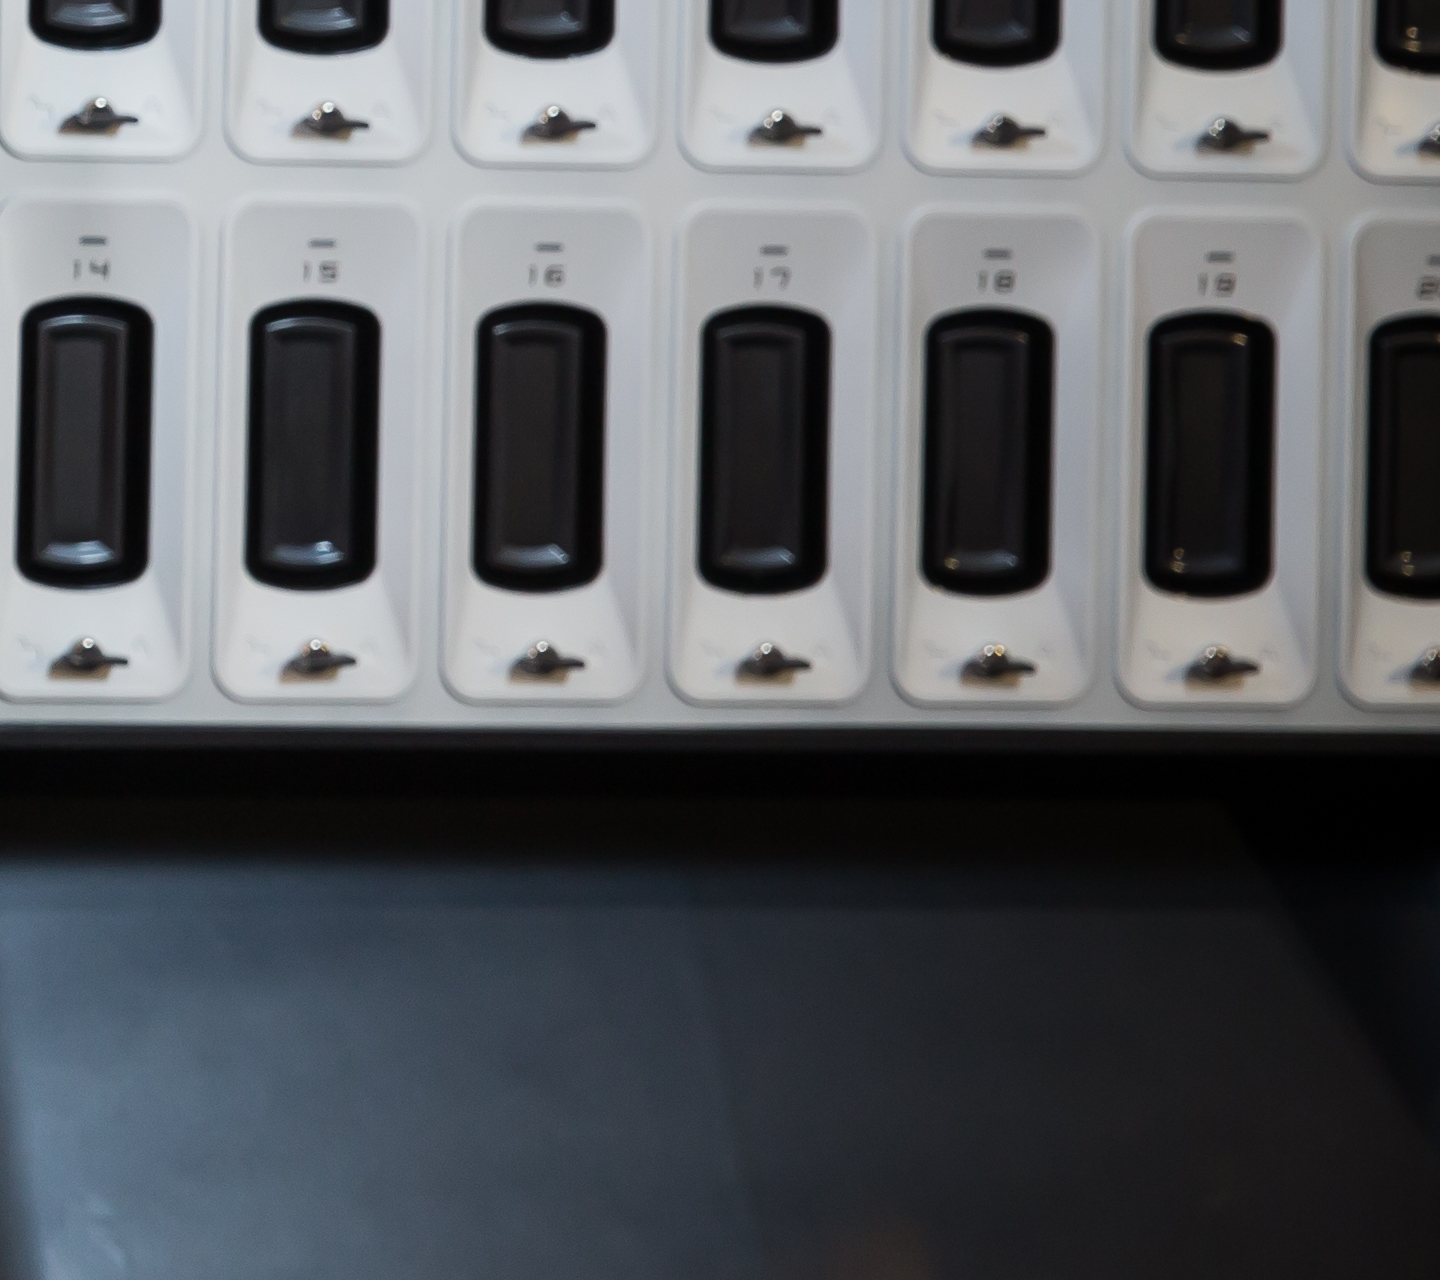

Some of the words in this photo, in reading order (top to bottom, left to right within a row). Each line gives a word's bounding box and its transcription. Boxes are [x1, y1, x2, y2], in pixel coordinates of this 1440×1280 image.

[72, 258, 111, 282] 14
[303, 260, 339, 284] 15
[528, 263, 565, 287] 16
